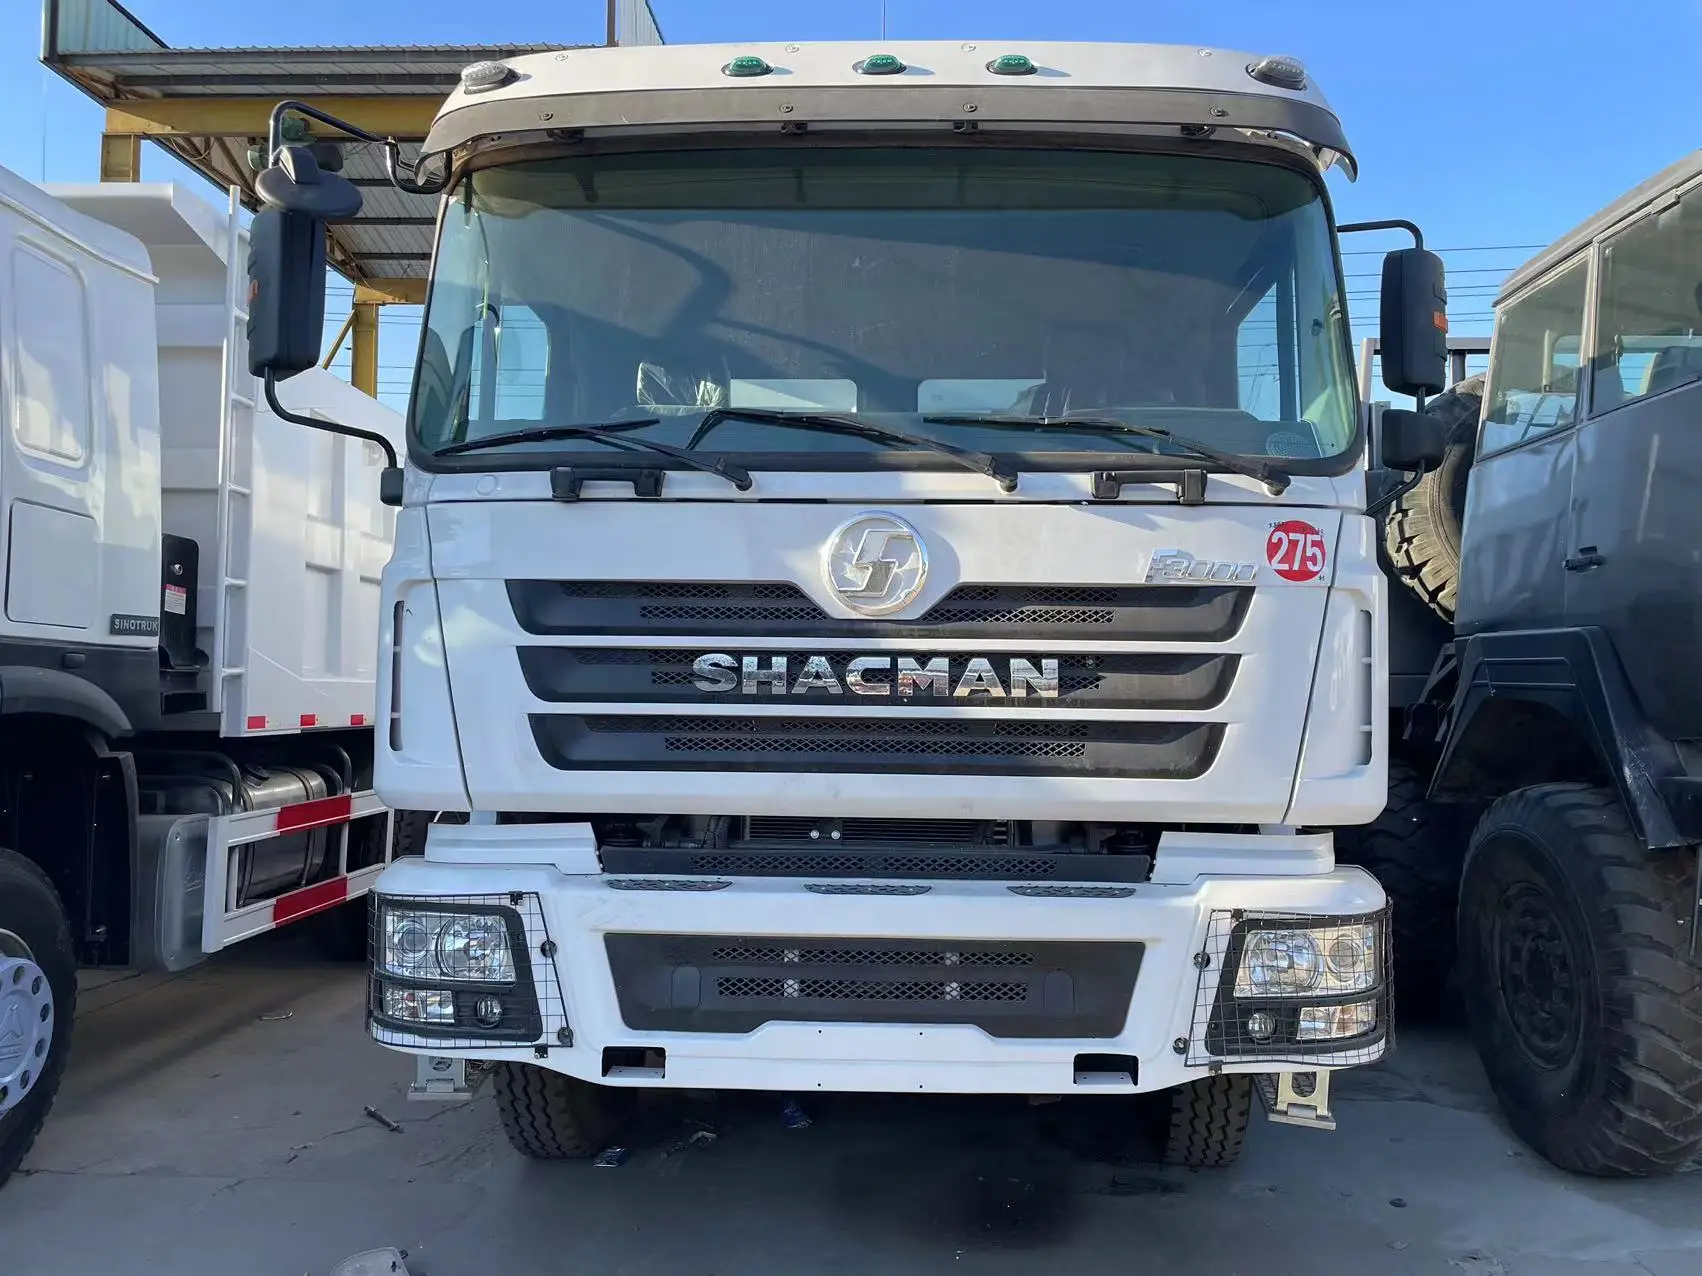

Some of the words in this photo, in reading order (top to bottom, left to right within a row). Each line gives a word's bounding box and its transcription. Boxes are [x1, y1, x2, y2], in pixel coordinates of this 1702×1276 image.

[1271, 530, 1324, 572] 275
[114, 618, 158, 632] SINOTRUK
[693, 653, 1059, 698] SHACMAN
